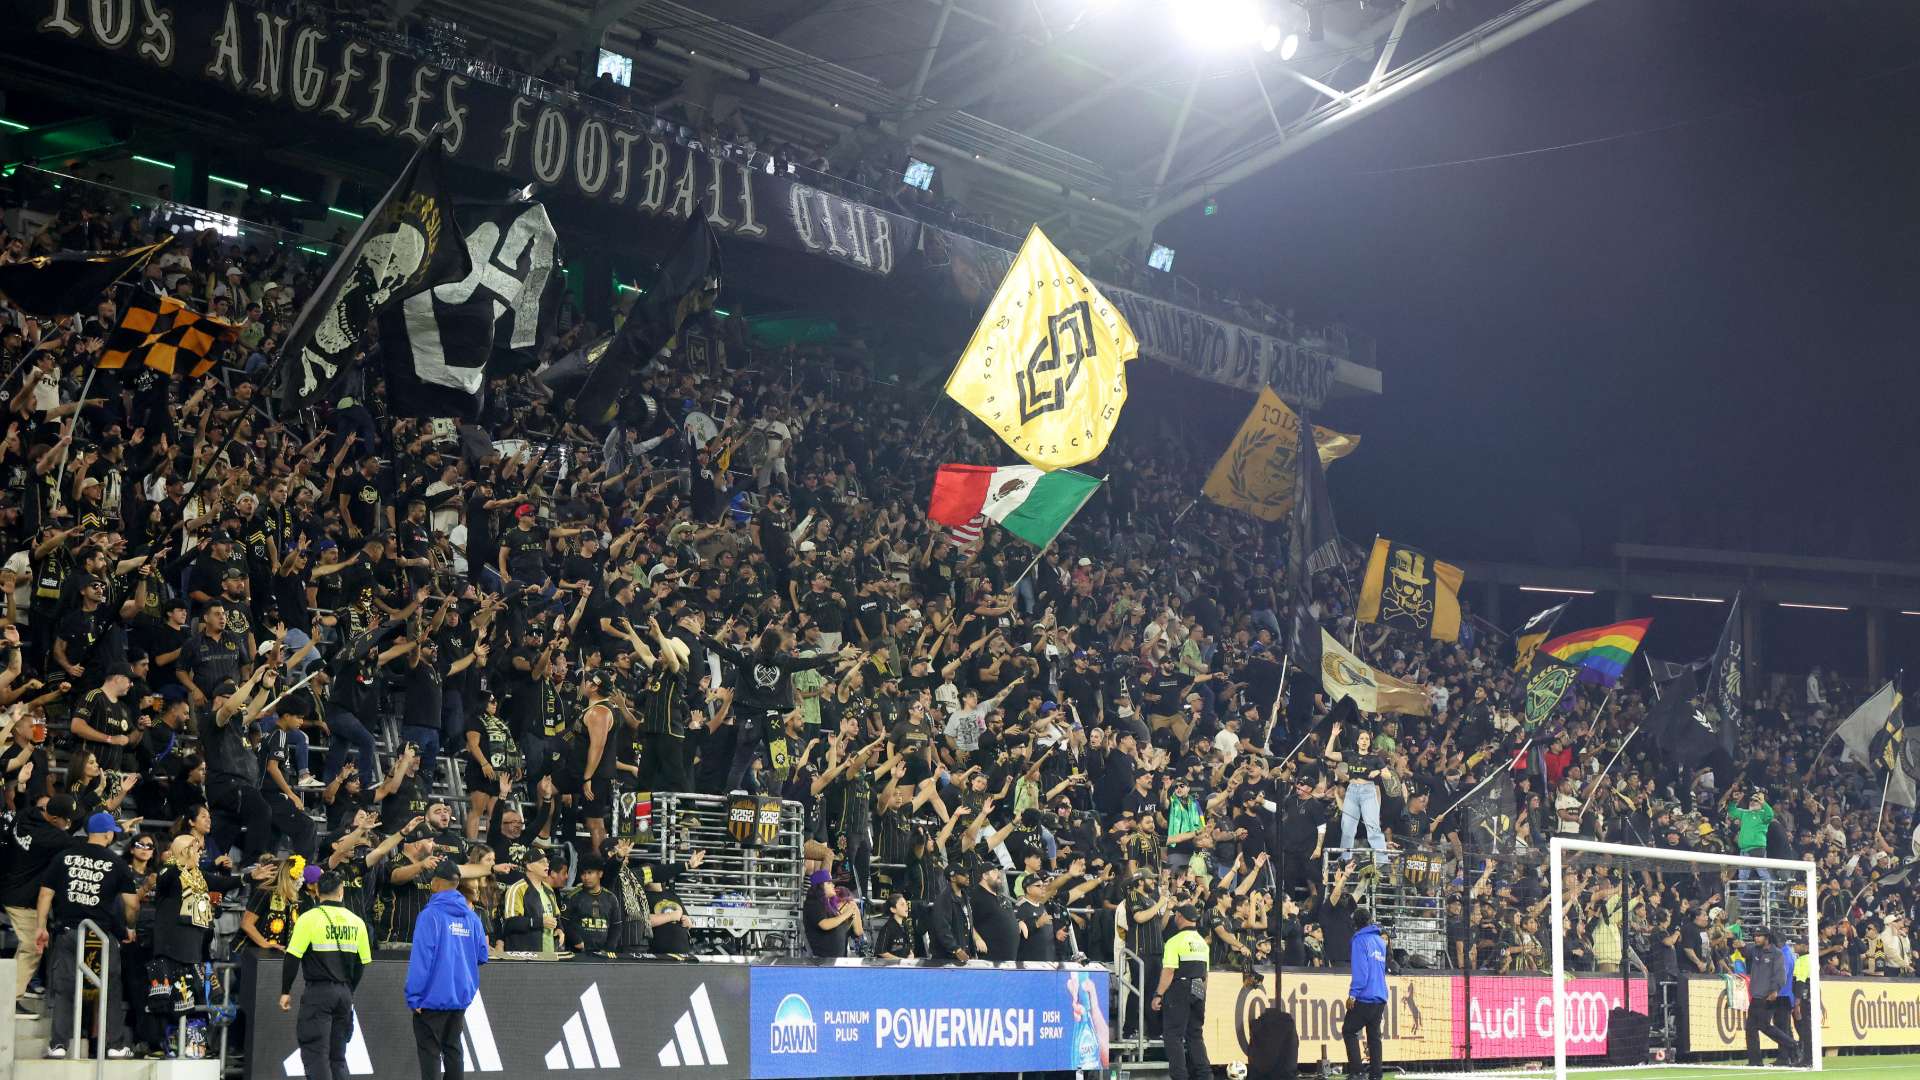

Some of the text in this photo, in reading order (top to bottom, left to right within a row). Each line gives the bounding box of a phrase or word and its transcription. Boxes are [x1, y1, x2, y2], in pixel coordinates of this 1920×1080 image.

[207, 0, 467, 154] ANGELES
[496, 96, 766, 236] FOOTBALL
[788, 182, 894, 272] CLUB
[730, 808, 755, 823] 3252
[759, 810, 779, 825] 3252
[63, 853, 114, 873] THREE
[68, 867, 105, 883] TWO
[68, 881, 101, 895] FIVE
[67, 892, 101, 907] TWO
[824, 1011, 870, 1026] PLATINUM
[1042, 1011, 1061, 1024] DISH
[1468, 997, 1525, 1039] Audi
[835, 1027, 859, 1042] PLUS
[875, 1007, 1035, 1049] POWERWASH
[1039, 1026, 1064, 1041] SPRAY
[770, 1022, 817, 1054] DAWN
